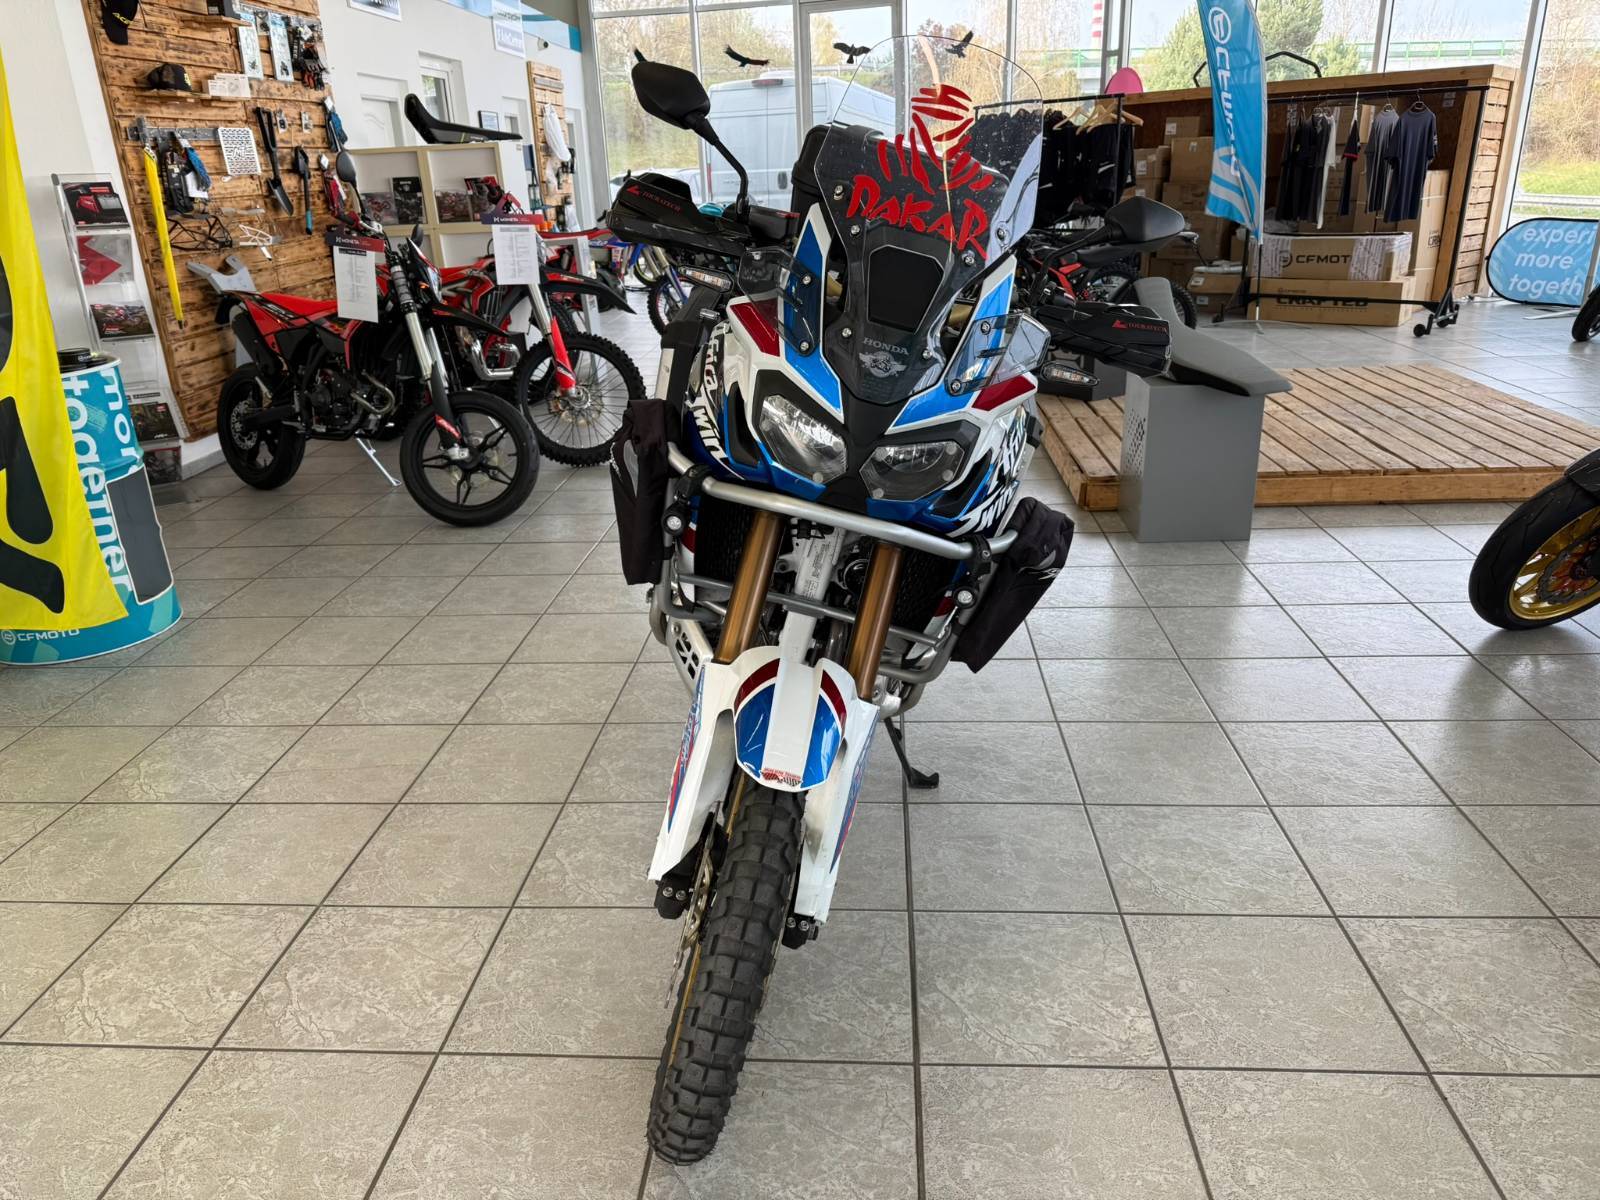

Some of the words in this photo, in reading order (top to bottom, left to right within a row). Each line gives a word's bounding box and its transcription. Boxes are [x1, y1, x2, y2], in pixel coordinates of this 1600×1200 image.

[846, 174, 989, 261] DAKAR
[1523, 225, 1597, 248] experi
[1295, 254, 1351, 264] CFMOT
[1514, 252, 1573, 270] more
[1508, 274, 1582, 299] togeth
[863, 336, 909, 355] HONDA
[100, 368, 143, 472] mor
[17, 628, 80, 641] CFMOTO
